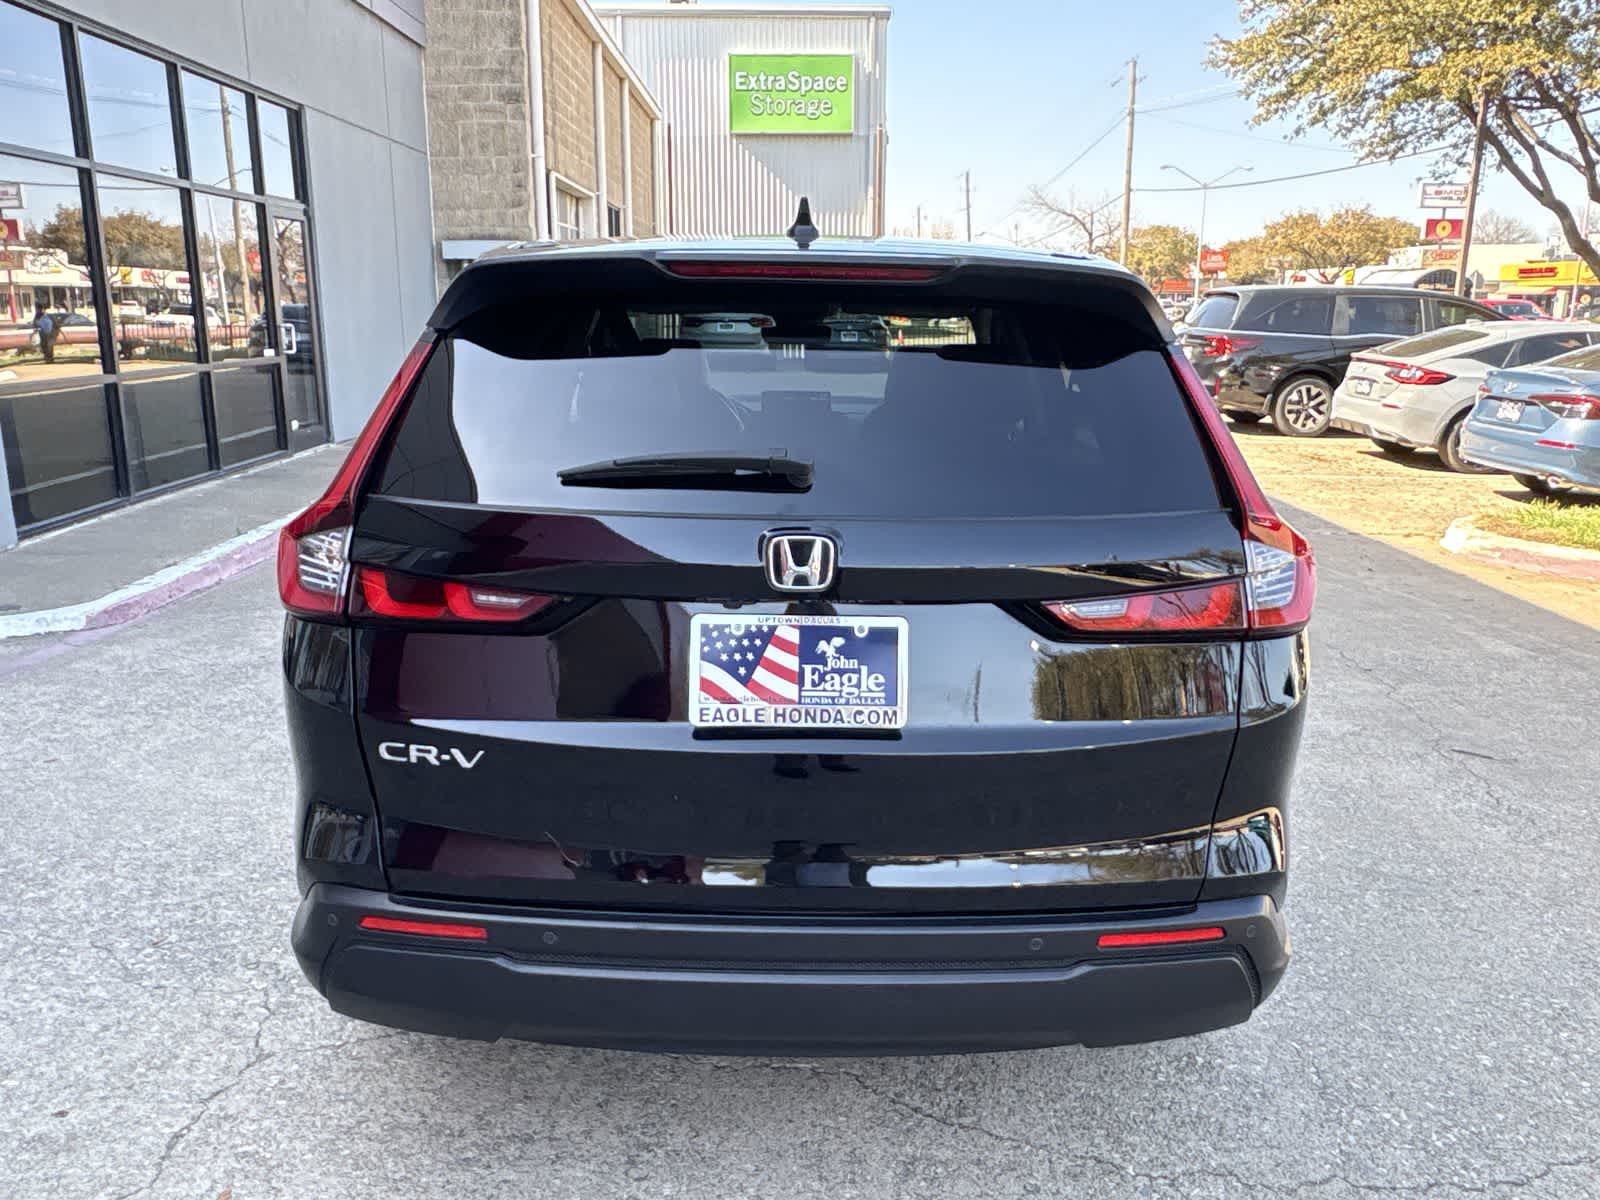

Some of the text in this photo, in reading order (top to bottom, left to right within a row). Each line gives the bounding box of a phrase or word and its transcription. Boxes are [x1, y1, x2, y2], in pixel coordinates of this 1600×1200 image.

[751, 93, 832, 120] Storage
[757, 616, 800, 625] UPTOWN
[823, 655, 858, 671] John
[801, 664, 885, 698] Eagle
[801, 696, 832, 704] HONDA
[849, 697, 885, 705] DALLAS
[378, 741, 485, 769] CR-V
